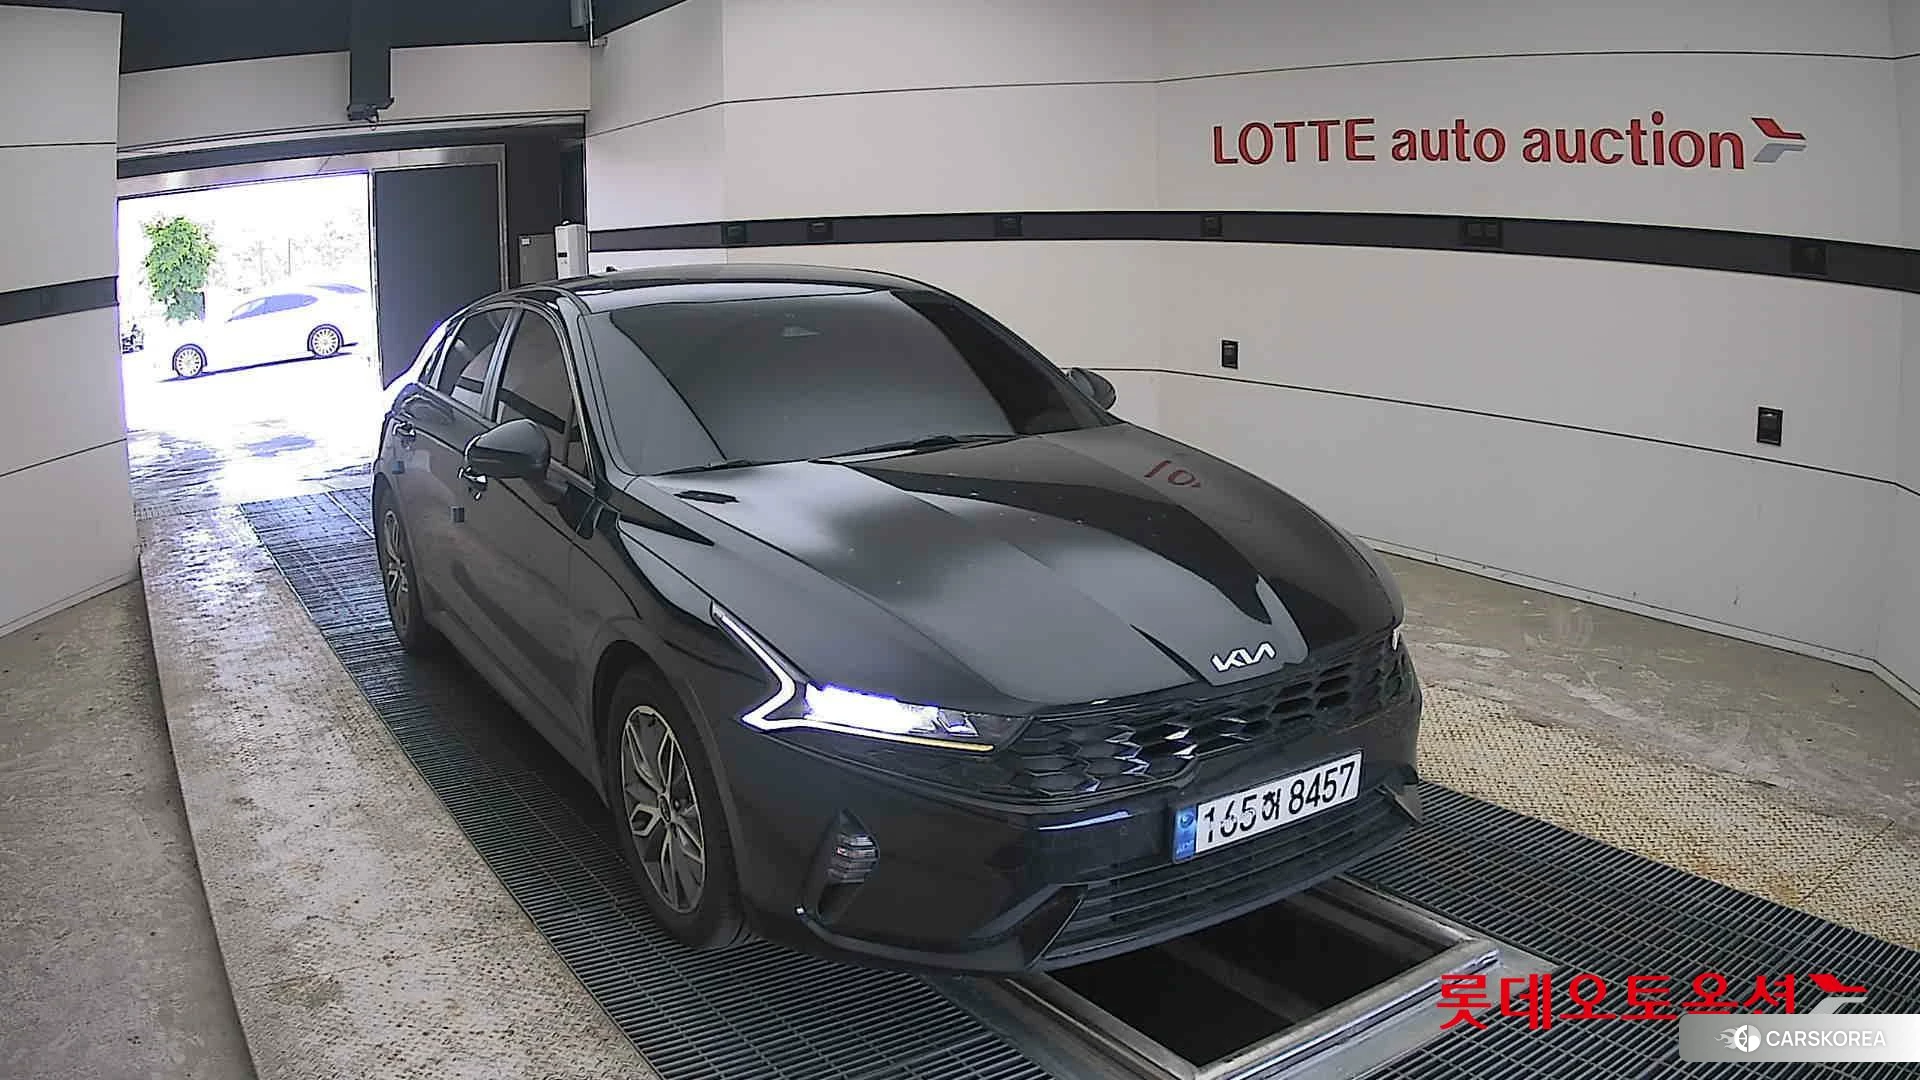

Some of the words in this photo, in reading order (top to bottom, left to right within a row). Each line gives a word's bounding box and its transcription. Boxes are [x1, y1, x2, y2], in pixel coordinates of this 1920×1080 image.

[1212, 117, 1377, 165] LOTTE
[1391, 118, 1507, 162] auto
[1521, 111, 1745, 169] auction
[1211, 642, 1276, 671] KIA
[1288, 761, 1356, 815] 8457
